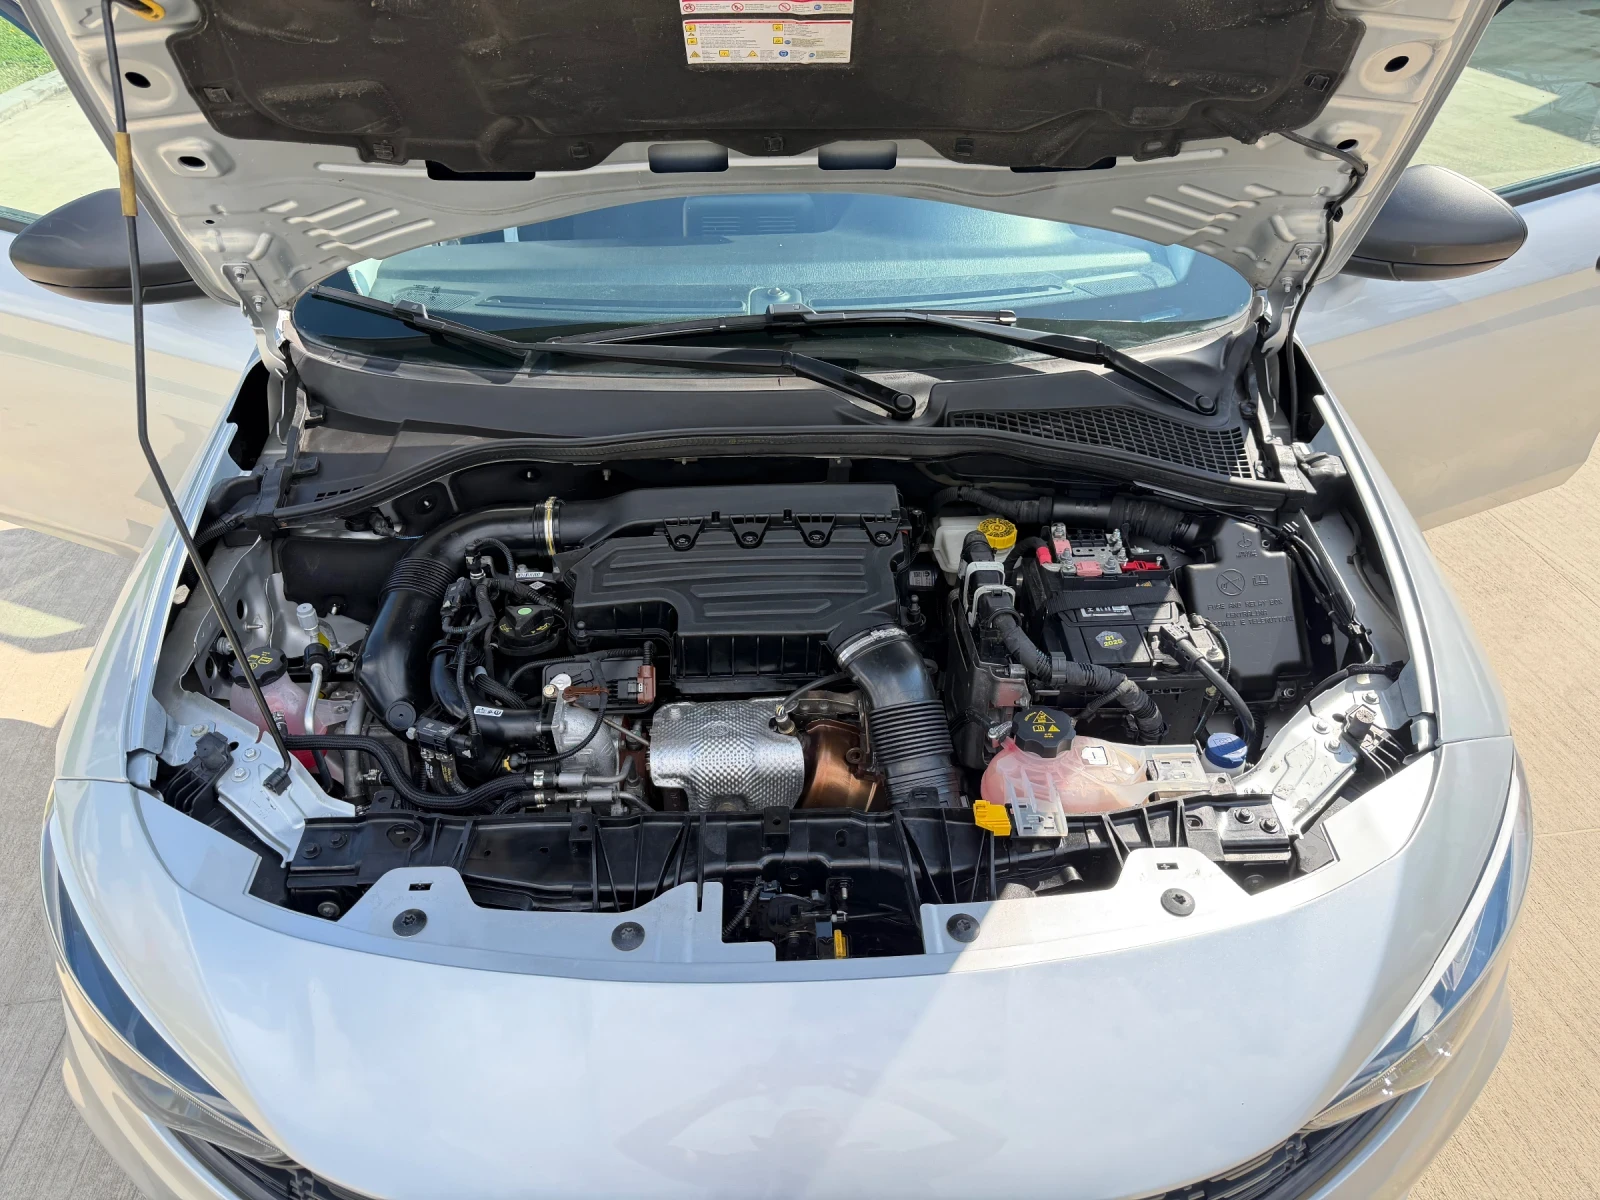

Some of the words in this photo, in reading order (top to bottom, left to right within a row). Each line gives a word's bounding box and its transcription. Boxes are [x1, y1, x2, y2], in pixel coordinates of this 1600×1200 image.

[1245, 600, 1267, 608] RELAY
[1269, 598, 1283, 606] BOX
[1226, 610, 1268, 618] CENTRALINA
